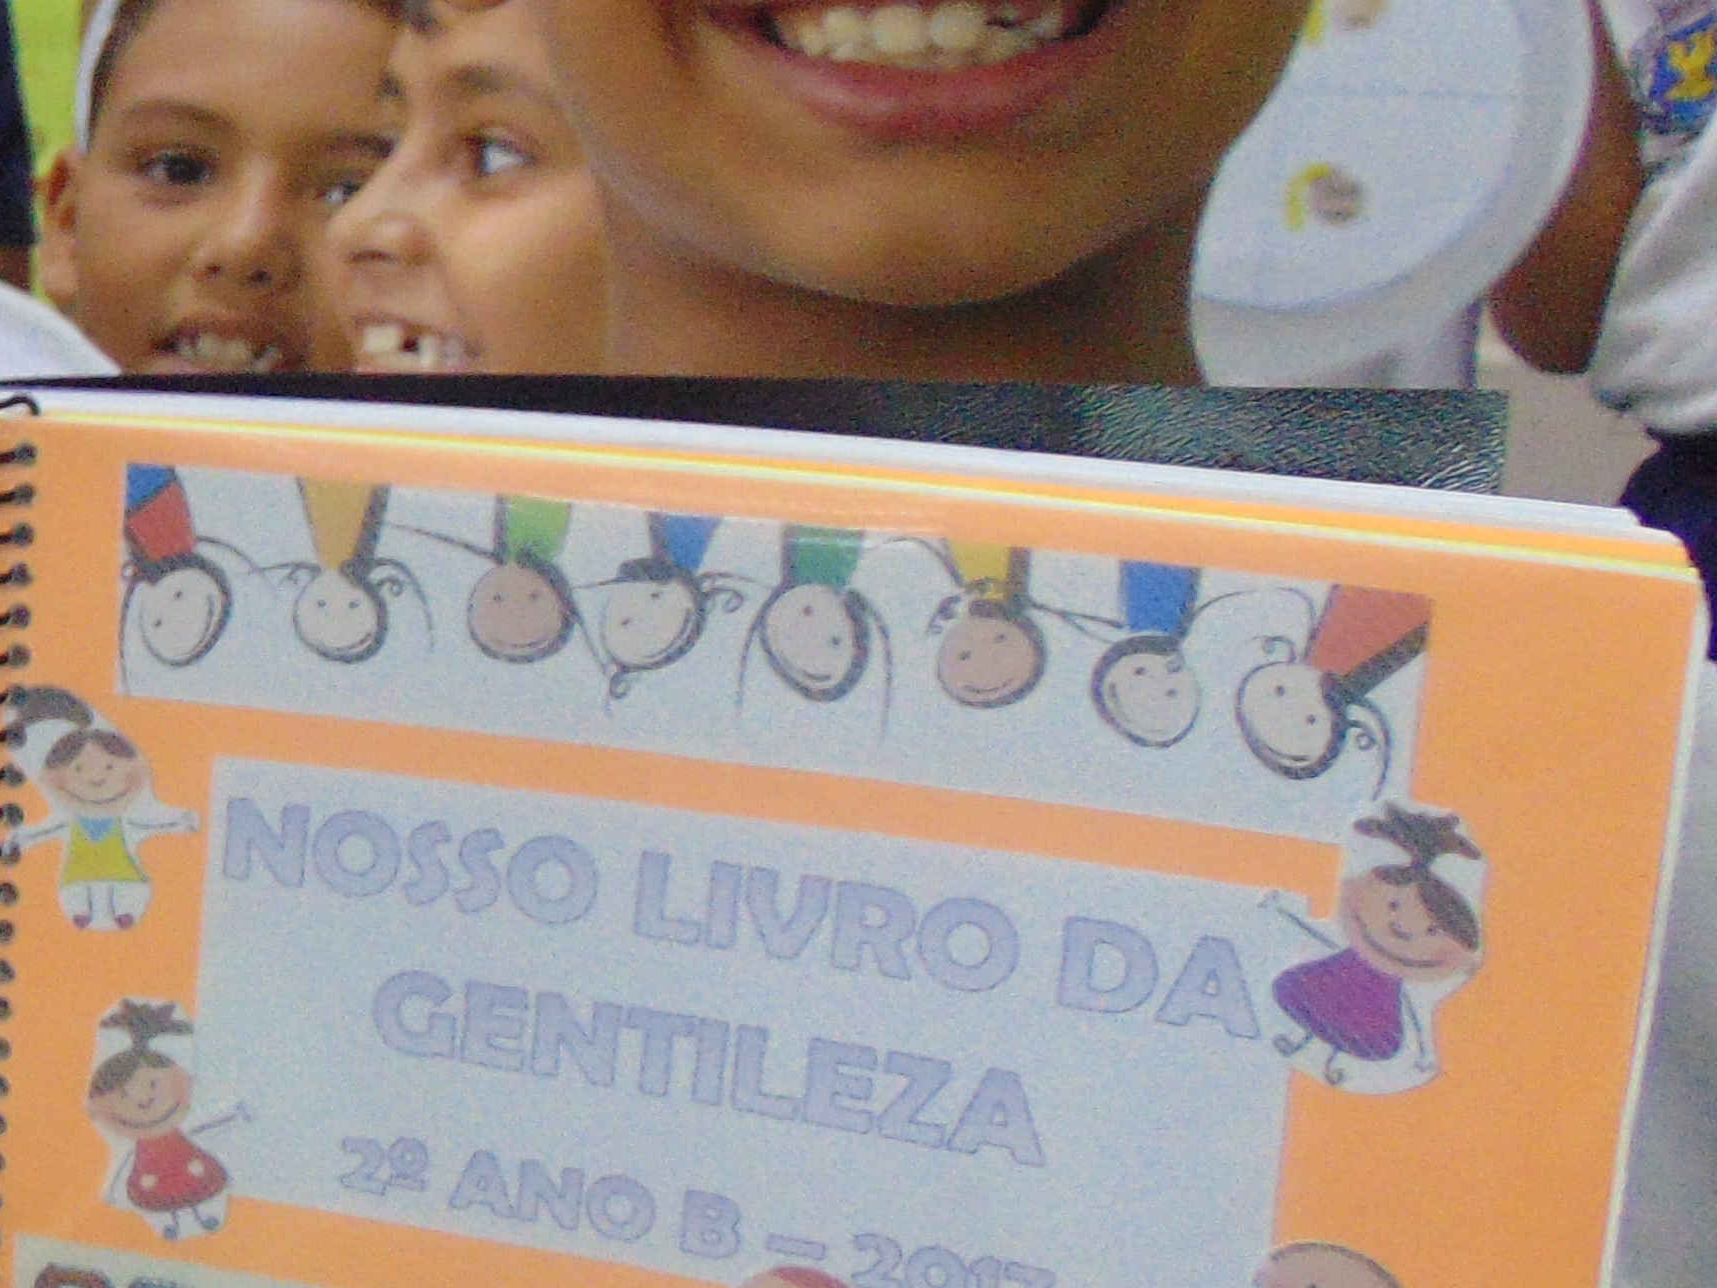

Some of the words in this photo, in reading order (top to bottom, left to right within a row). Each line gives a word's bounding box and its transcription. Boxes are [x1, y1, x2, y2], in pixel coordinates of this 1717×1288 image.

[223, 797, 599, 925] NOSSO
[634, 851, 1021, 993] LIVRO
[1056, 915, 1260, 1039] DA
[373, 969, 1046, 1168] GENTILEZA
[339, 1136, 430, 1196] 2º
[449, 1149, 657, 1242] ANO
[680, 1189, 743, 1259] B
